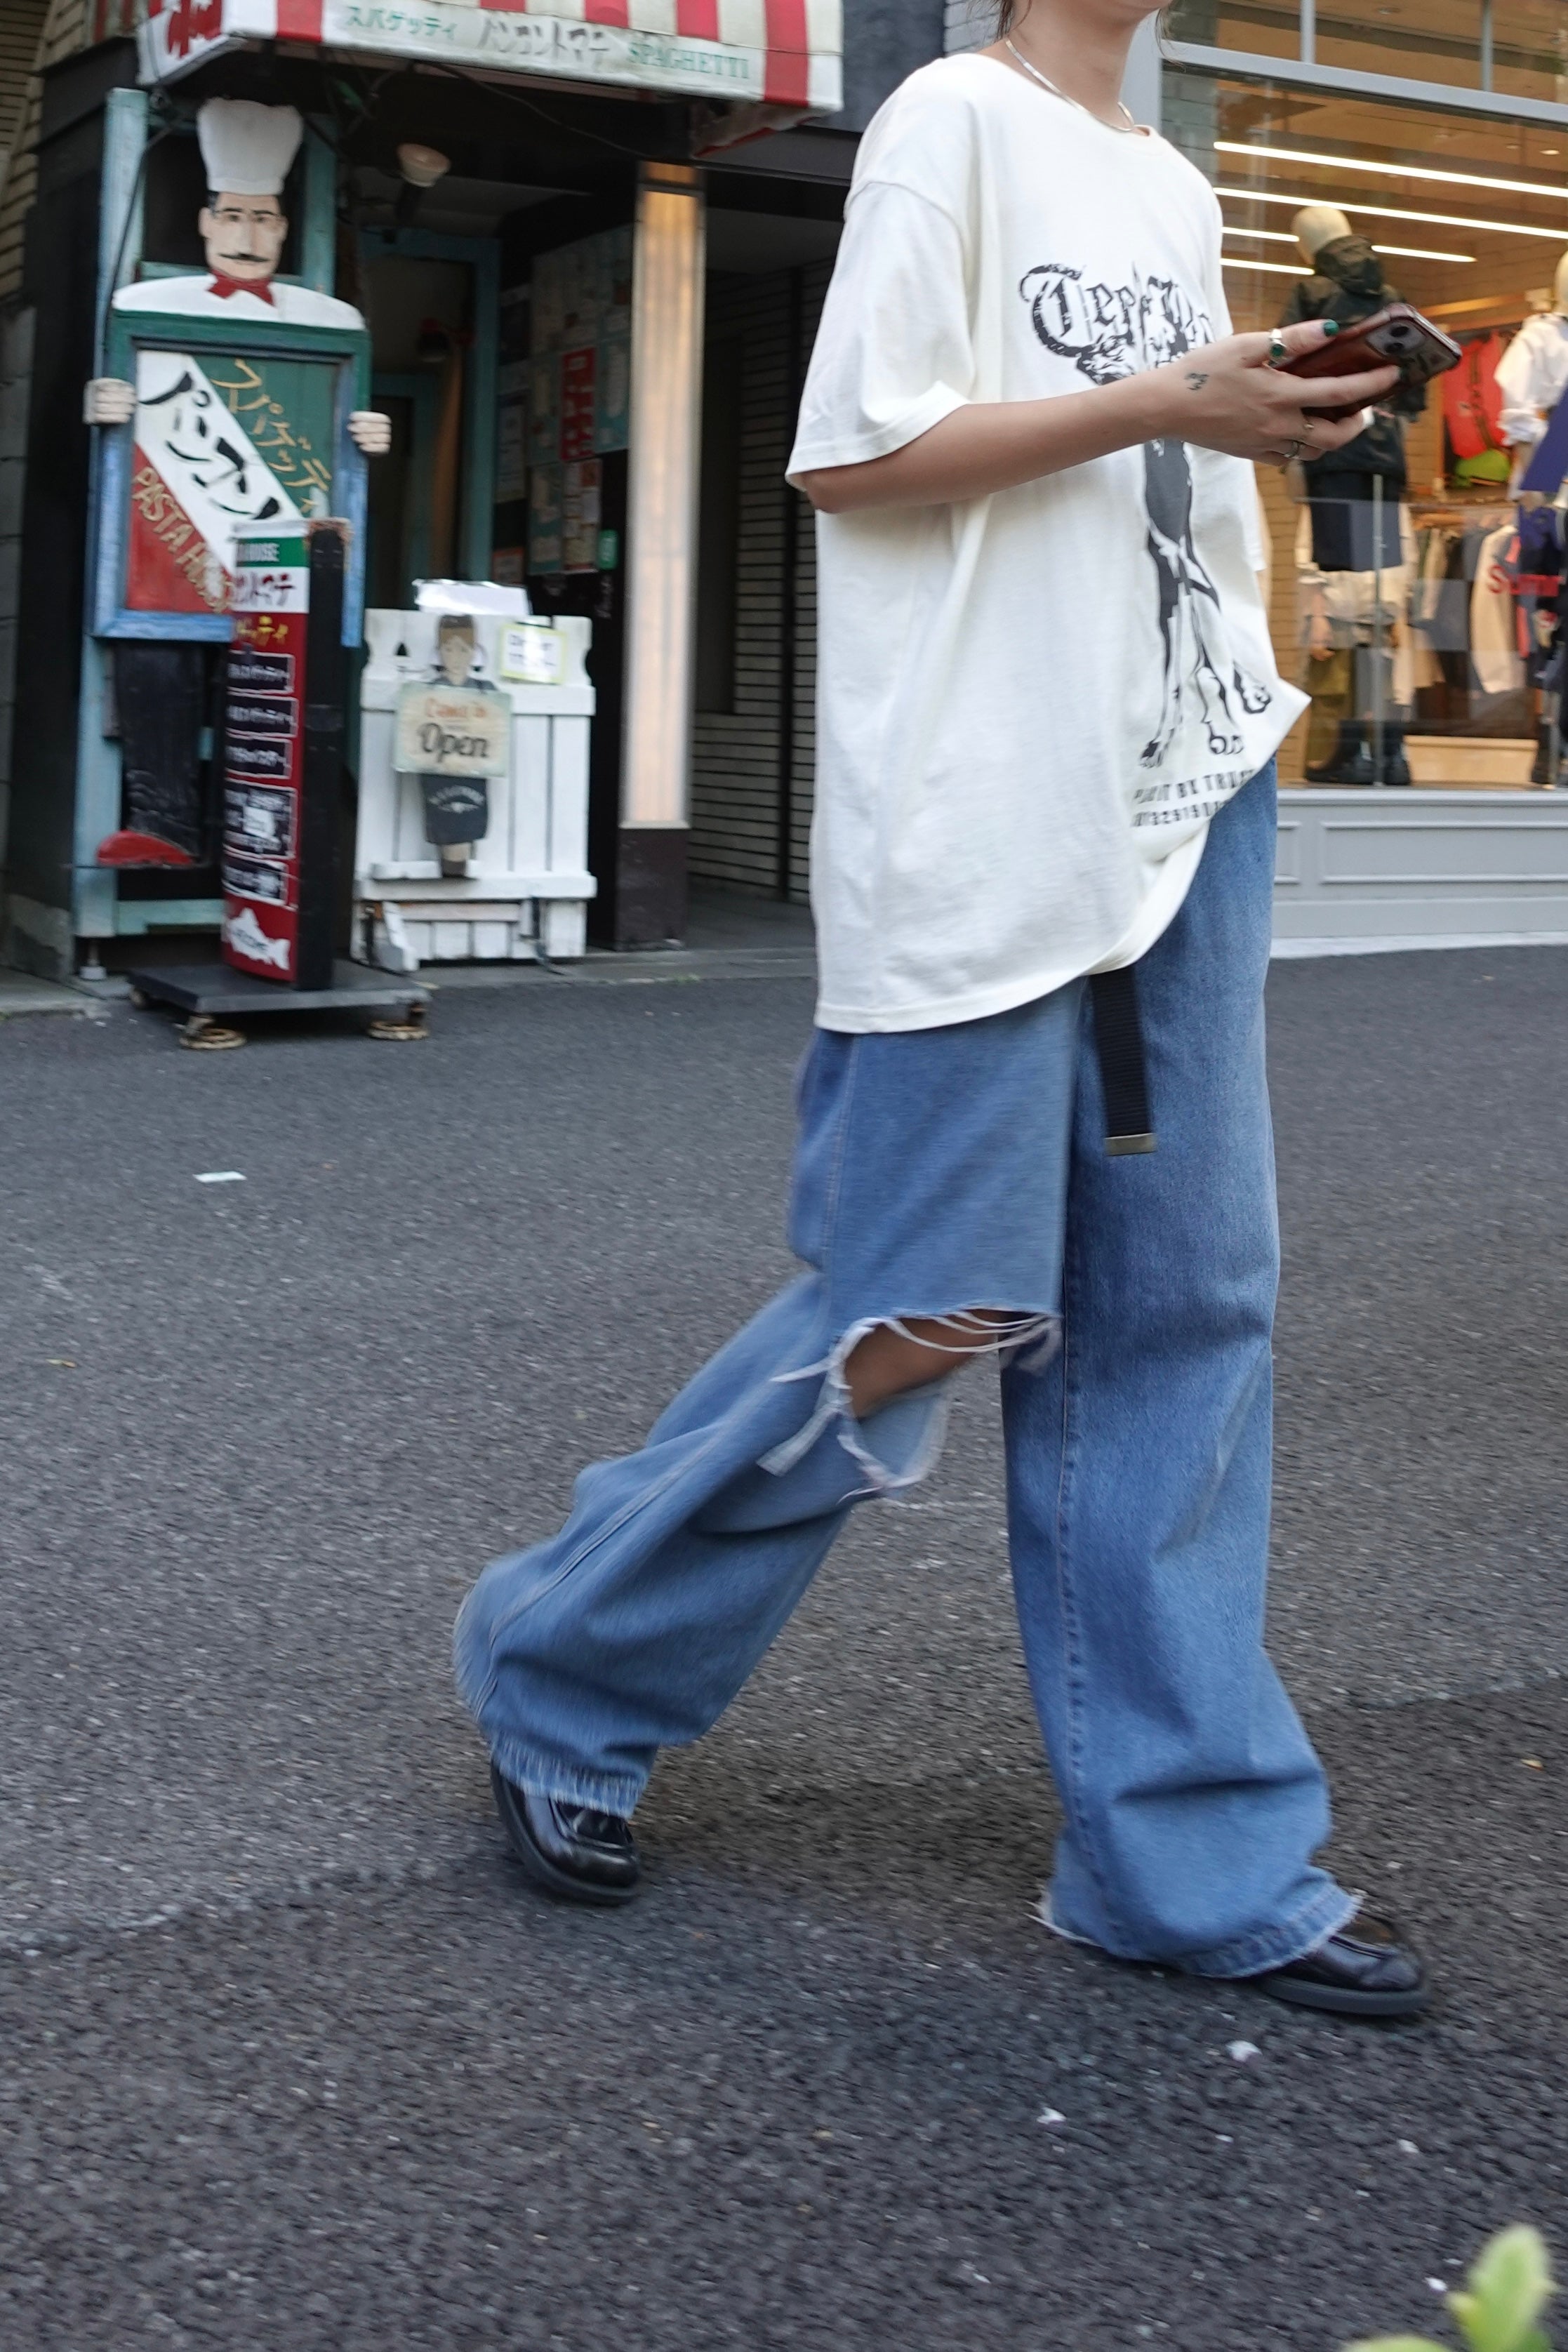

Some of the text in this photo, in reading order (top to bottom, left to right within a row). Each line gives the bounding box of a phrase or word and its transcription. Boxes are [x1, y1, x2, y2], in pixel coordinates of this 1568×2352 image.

[347, 6, 456, 39] スパゲッティ
[628, 43, 750, 79] SPAGHETTI
[139, 370, 279, 519] パンコン
[132, 466, 196, 554] PASTA
[418, 723, 489, 764] Open
